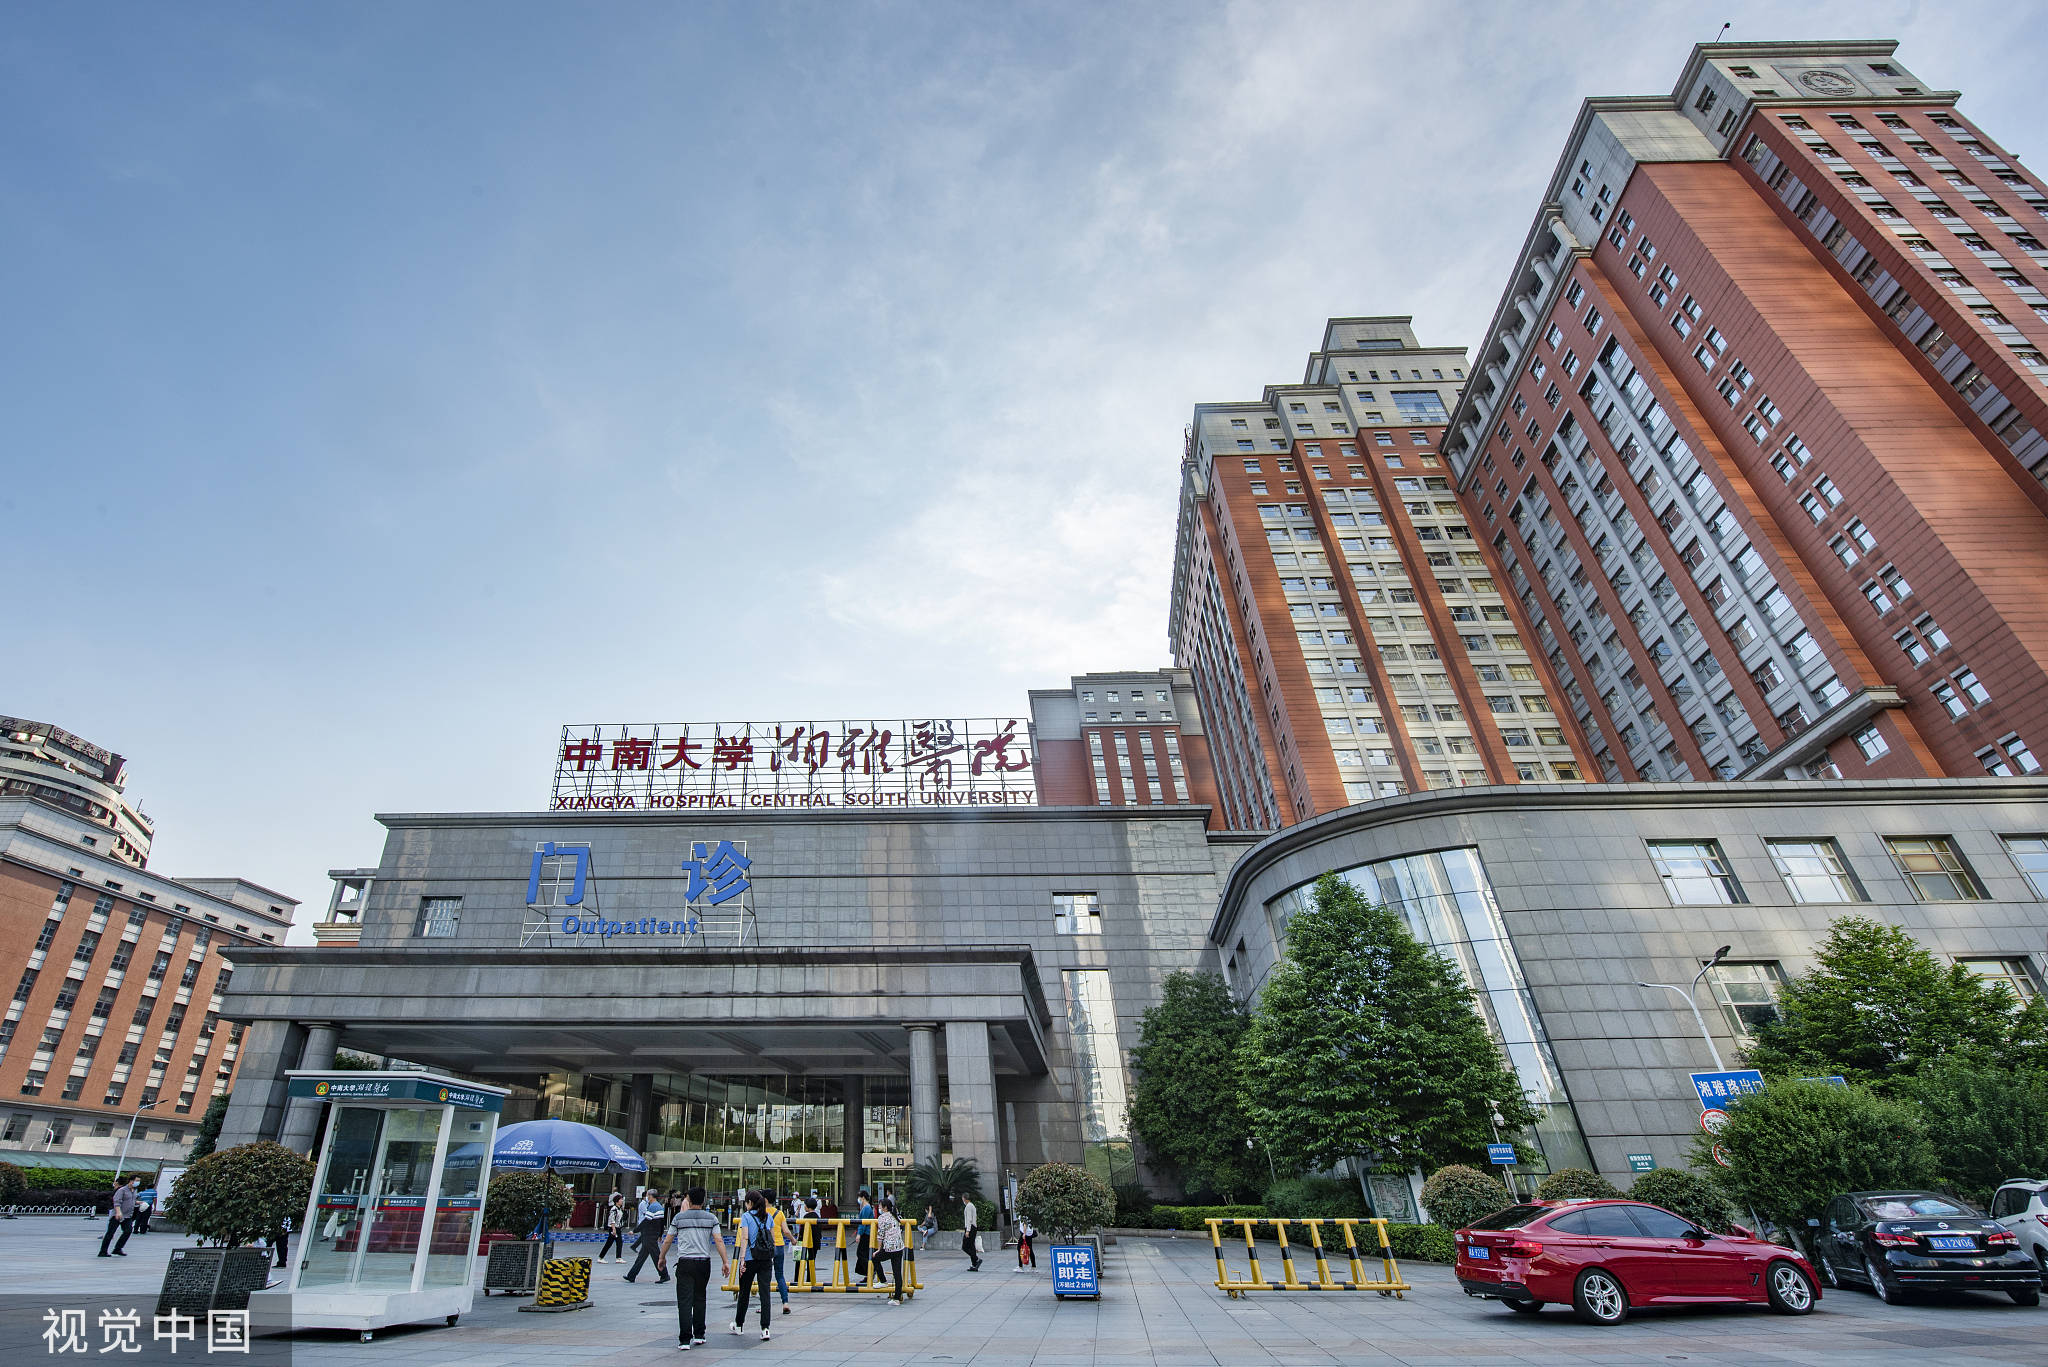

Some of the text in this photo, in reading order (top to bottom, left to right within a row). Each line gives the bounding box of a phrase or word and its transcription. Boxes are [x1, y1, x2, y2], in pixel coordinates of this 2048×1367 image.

[556, 790, 1033, 810] XIANGYA HOSPITAL CENTRAL SOUTH UNIVERSITY
[526, 840, 753, 906] 门诊
[561, 916, 699, 939] Outpatient
[1696, 1077, 1767, 1098] 湘雅路出口
[692, 1154, 719, 1165] 入口
[762, 1155, 791, 1165] 入口
[883, 1156, 905, 1167] 出口
[1056, 1251, 1091, 1265] 即停
[1058, 1266, 1092, 1280] 即走
